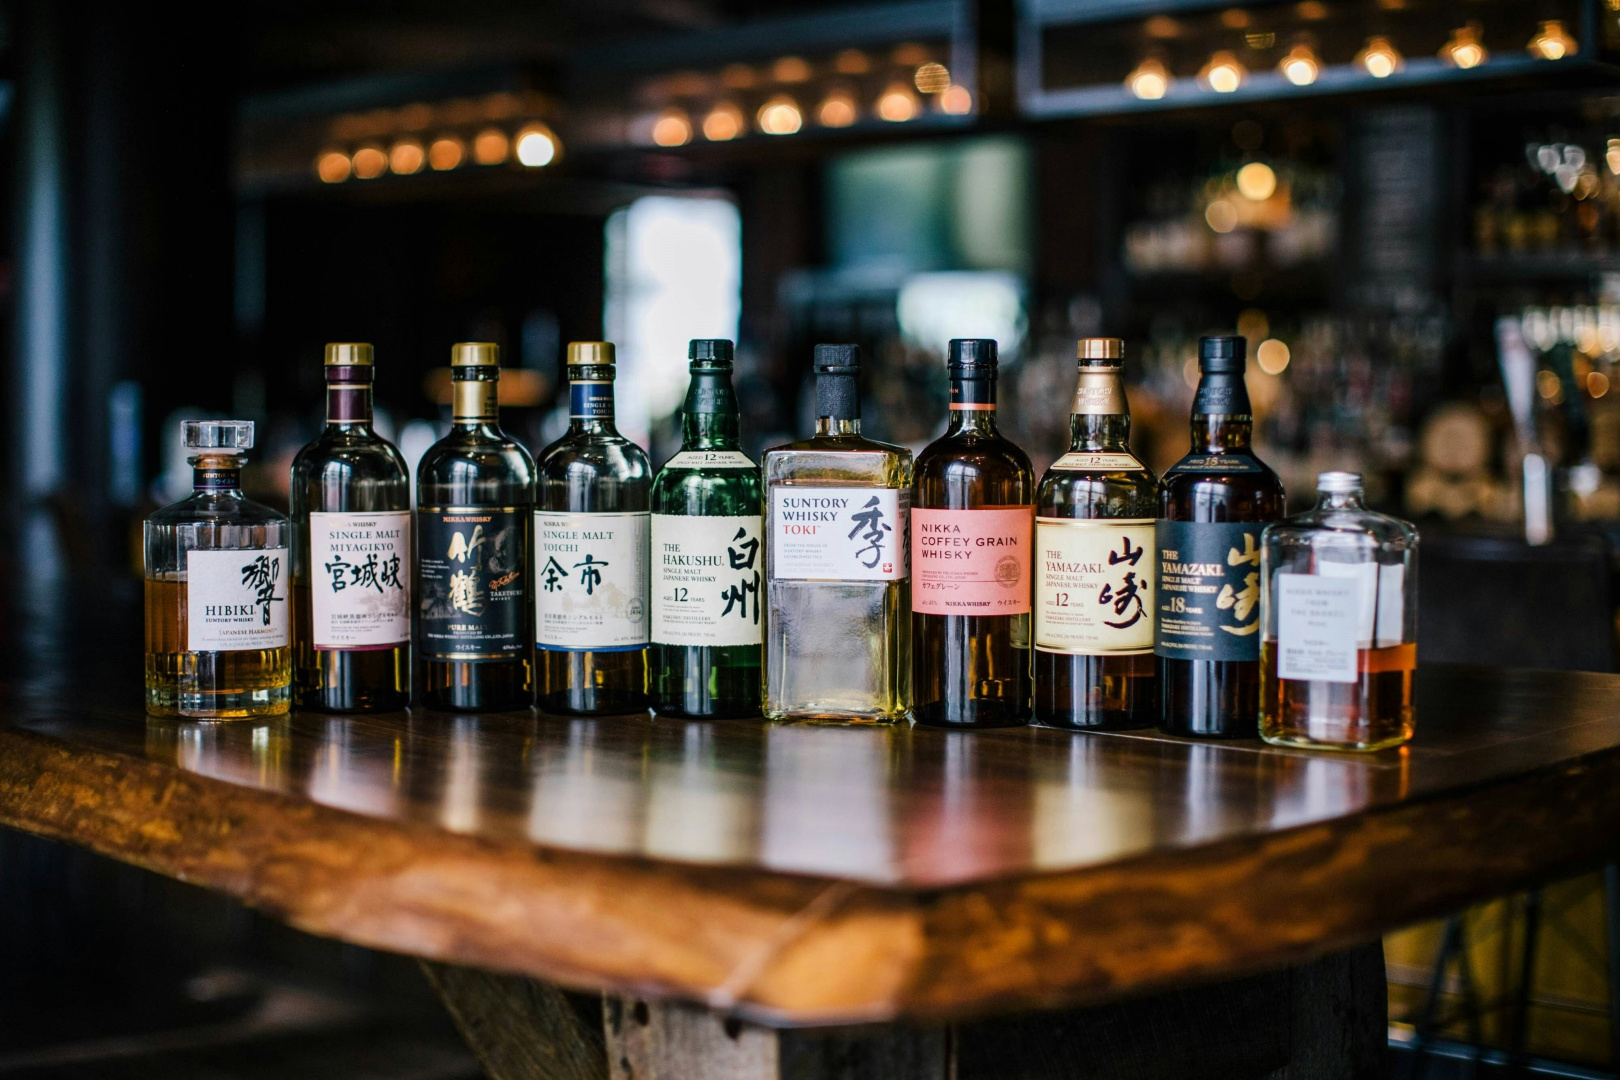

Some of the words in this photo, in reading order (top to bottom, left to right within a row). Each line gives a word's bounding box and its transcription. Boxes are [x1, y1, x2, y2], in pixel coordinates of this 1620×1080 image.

[782, 498, 849, 508] SUNTORY
[782, 511, 838, 521] WHISKY
[782, 525, 816, 534] TOKI
[848, 496, 892, 568] 季
[922, 524, 960, 533] NIKKA
[329, 531, 372, 540] SINGLE
[376, 530, 400, 538] MALT
[543, 530, 578, 540] SINGLE
[582, 532, 614, 540] MALT
[922, 536, 970, 546] COFFEY
[976, 537, 1018, 546] GRAIN
[330, 543, 394, 552] MIYAGIKYO
[544, 544, 578, 552] YOICHI
[663, 544, 680, 552] THE
[922, 550, 972, 559] WHISKY
[1046, 550, 1062, 560] THE
[1162, 550, 1178, 560] THE
[663, 555, 722, 566] HAKUSHU
[1046, 562, 1102, 574] YAMAZAKI
[1162, 562, 1223, 576] YAMAZAKI
[541, 554, 609, 595] 余市
[721, 527, 760, 625] 白州
[241, 555, 284, 626] 響
[1162, 584, 1187, 592] JAPANESE
[1188, 585, 1217, 594] WHISKY
[674, 588, 688, 602] 12
[1056, 593, 1068, 606] 12
[1170, 597, 1186, 613] 18
[205, 605, 254, 616] HIBIKI
